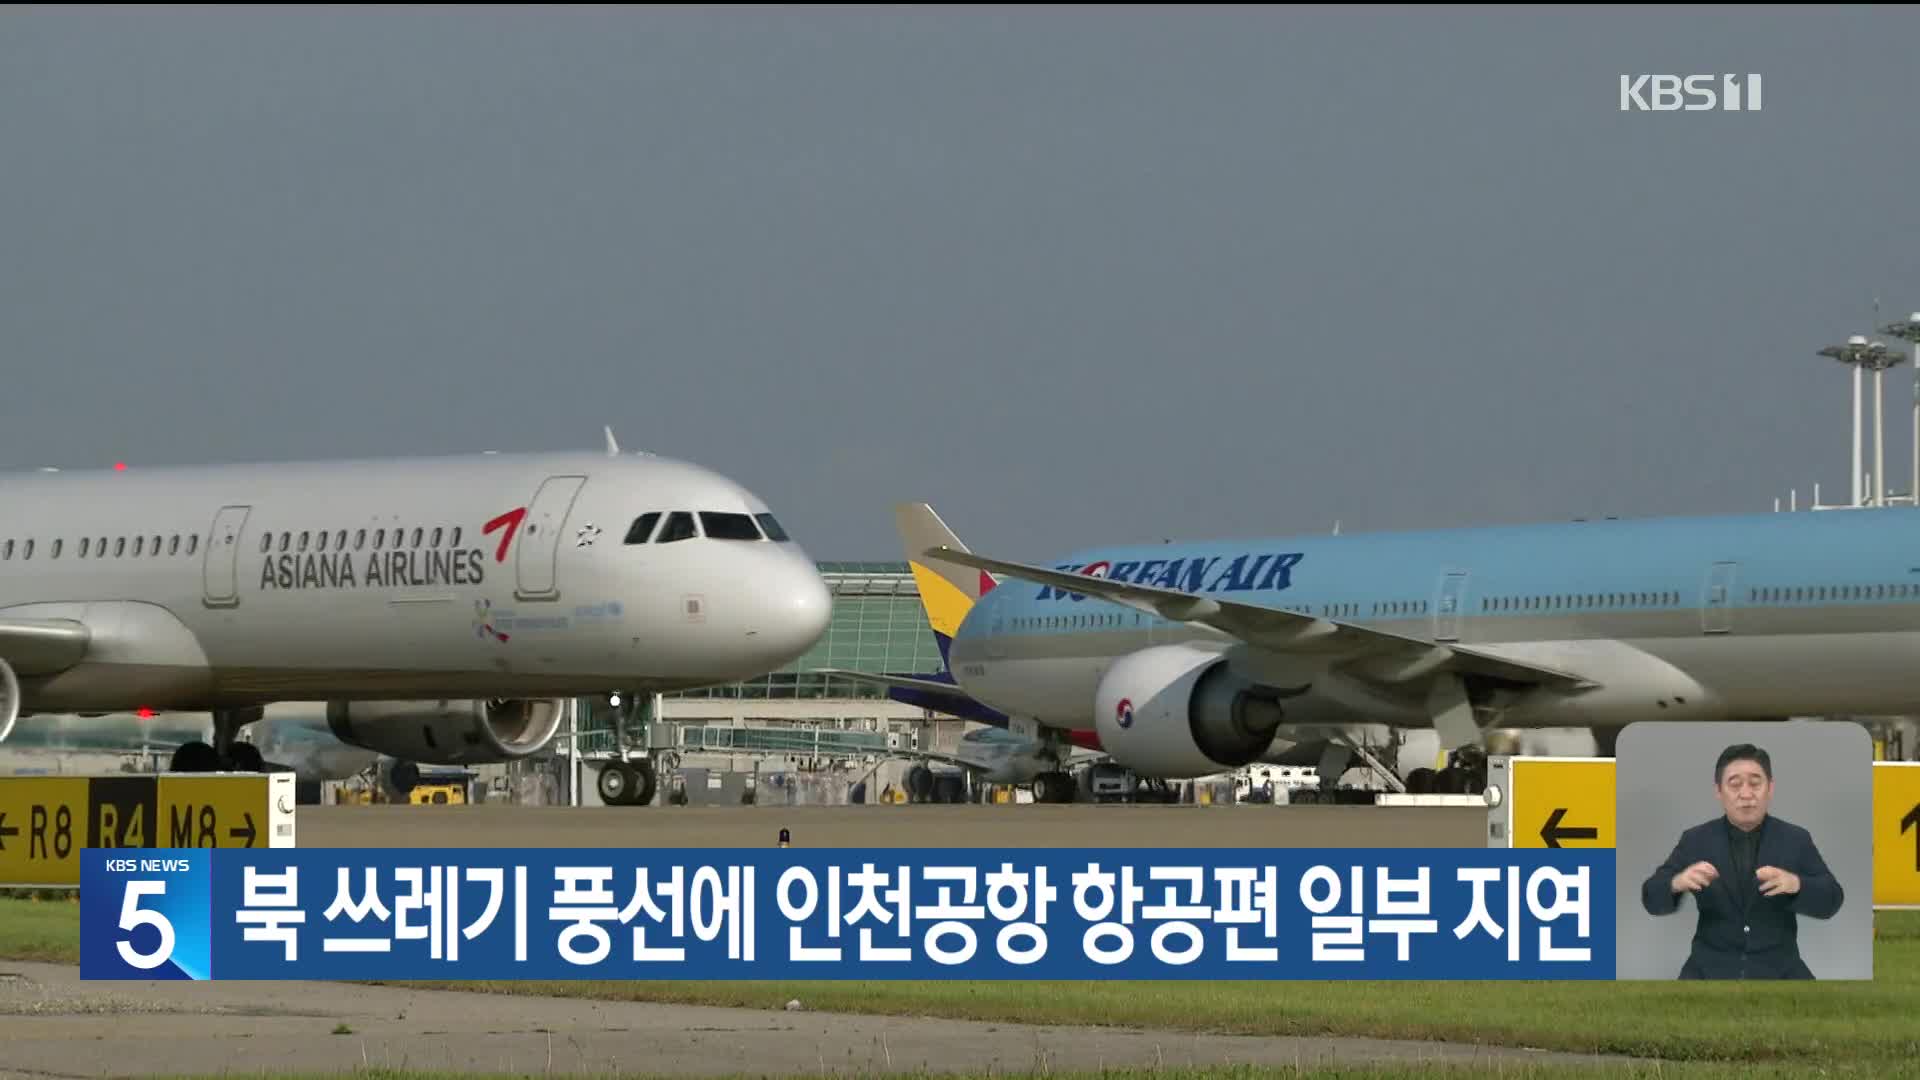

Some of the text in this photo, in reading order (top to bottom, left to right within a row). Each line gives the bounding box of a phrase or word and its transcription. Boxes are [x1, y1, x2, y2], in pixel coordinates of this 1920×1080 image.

[260, 548, 484, 590] ASIANA AIRLINES
[1207, 552, 1304, 592] AIR
[29, 802, 218, 860] R8 R4 M8
